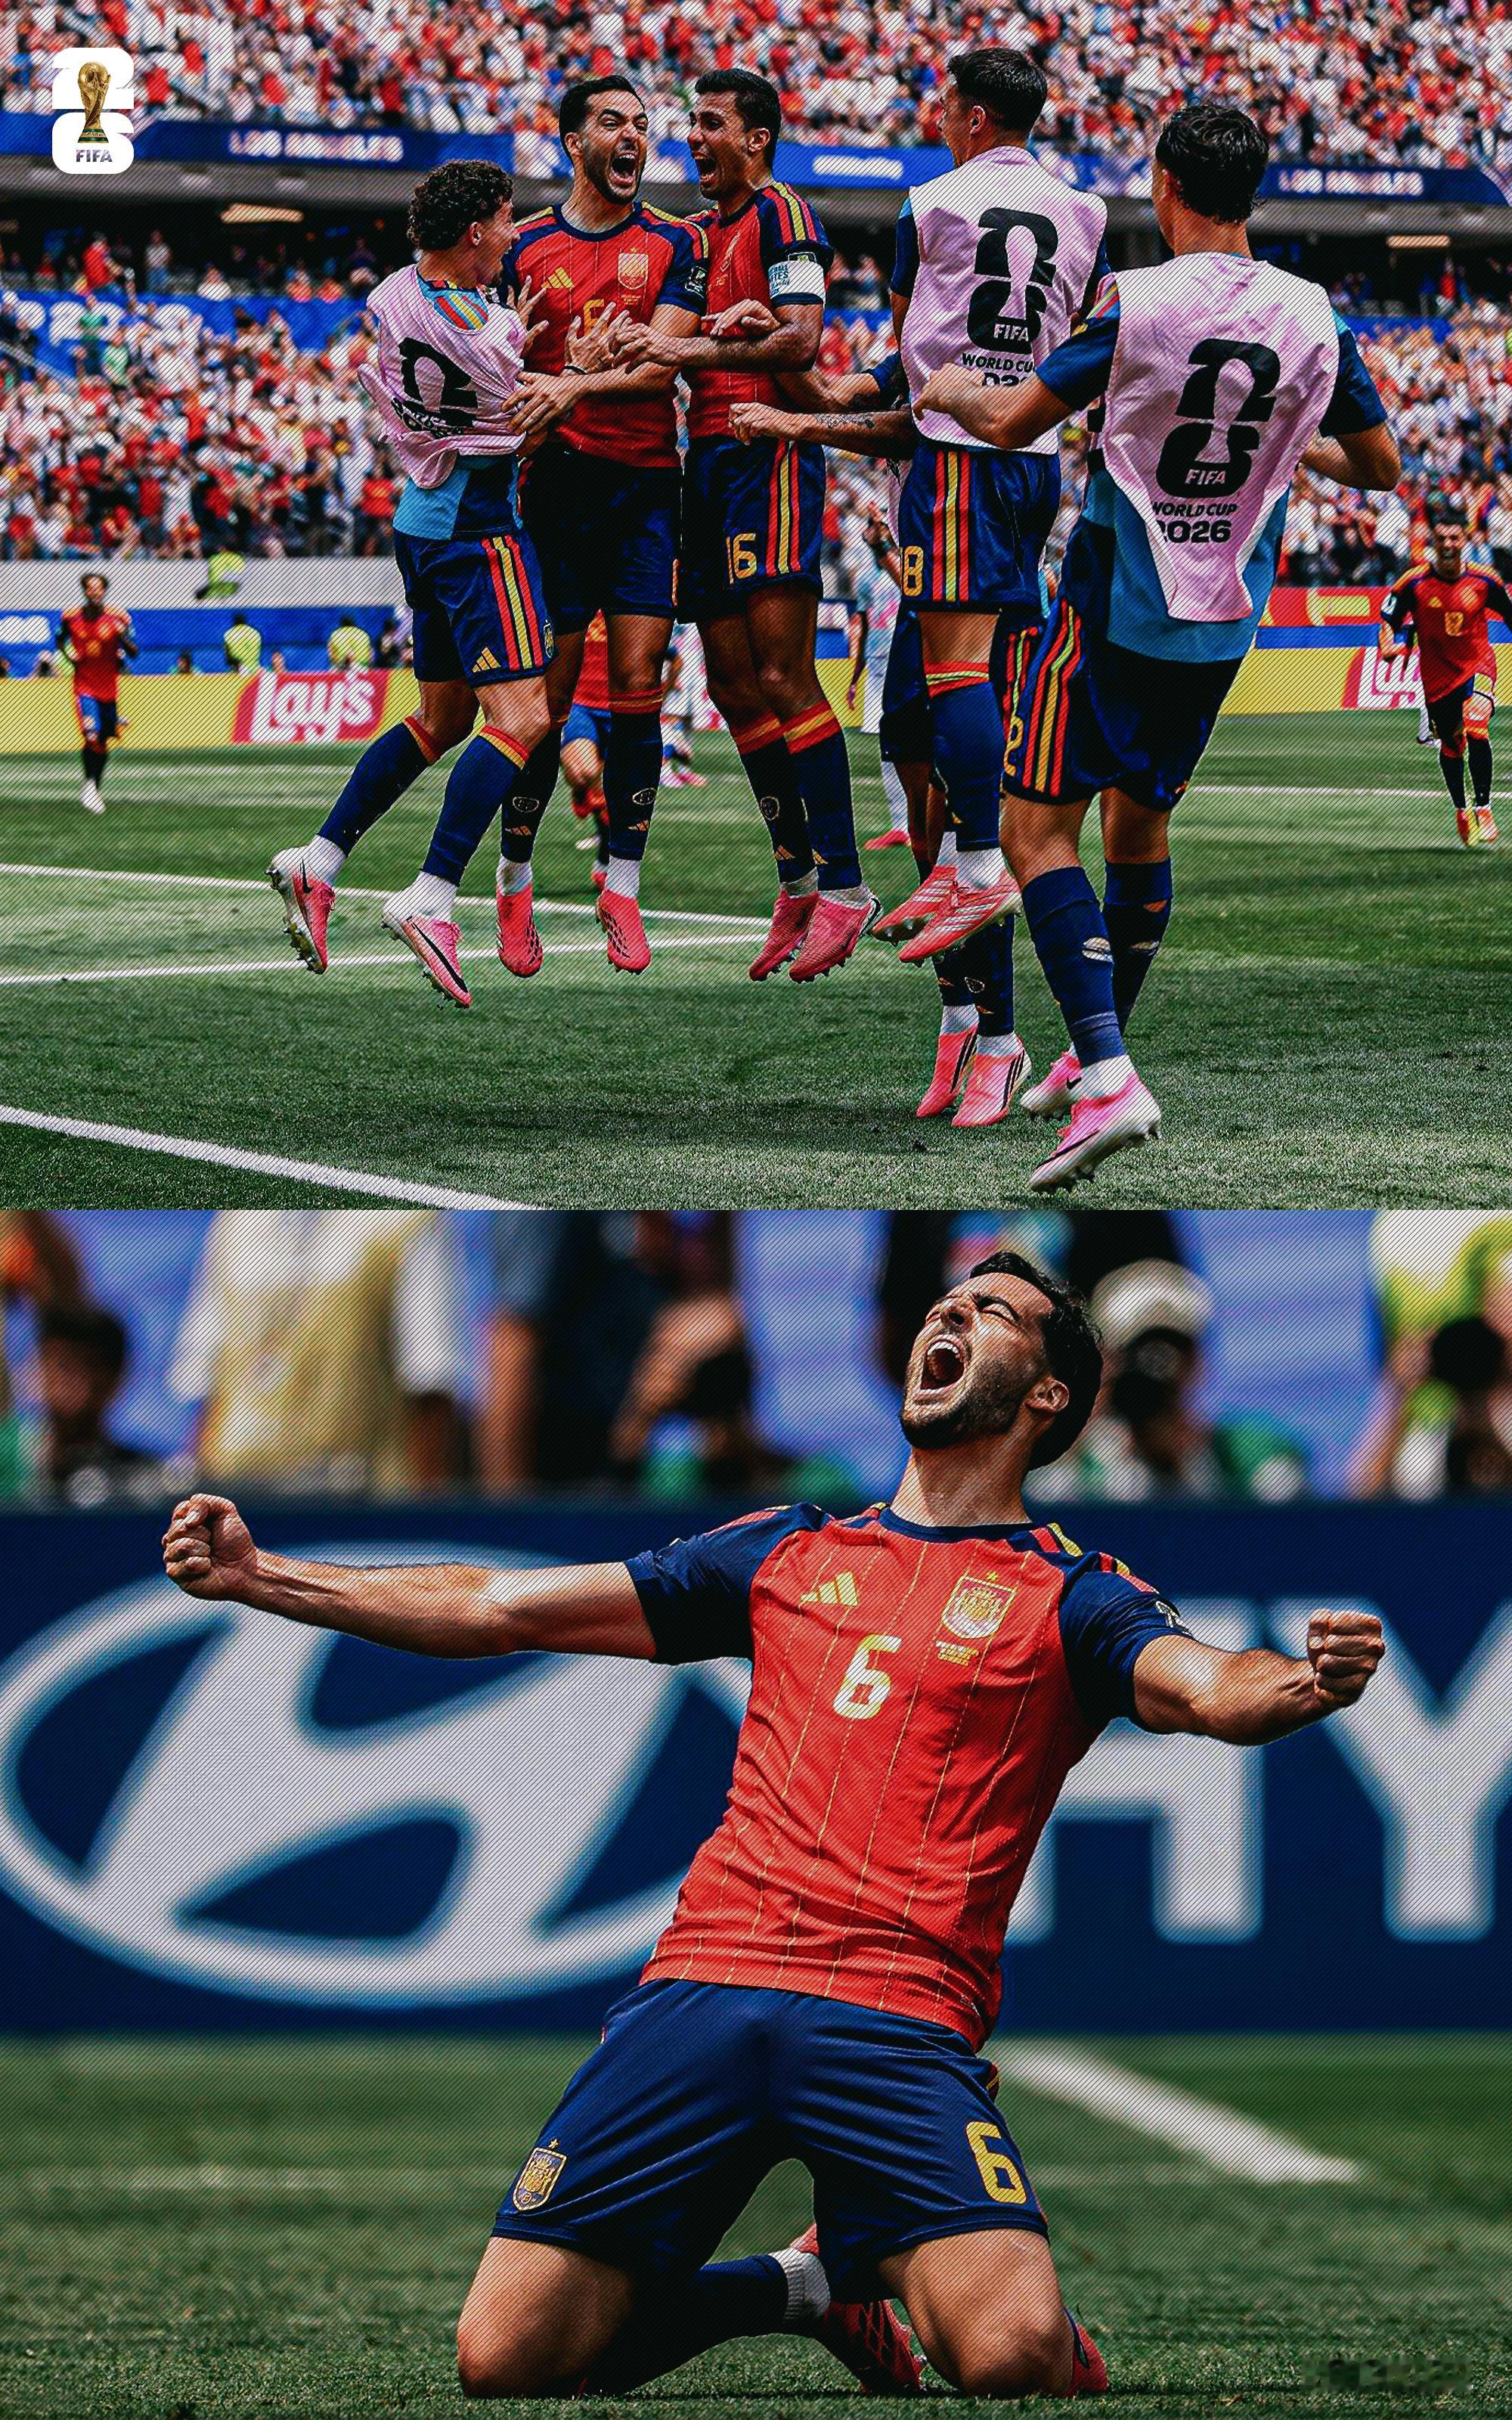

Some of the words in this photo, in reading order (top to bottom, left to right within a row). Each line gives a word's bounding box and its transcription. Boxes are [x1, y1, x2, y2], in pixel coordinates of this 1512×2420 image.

[993, 323, 1029, 342] FIFA
[962, 352, 1014, 371] WORLD
[1016, 361, 1035, 374] CU
[1185, 468, 1226, 486] FIFA
[1151, 501, 1206, 517] WORLD
[1207, 503, 1238, 517] CUP
[249, 670, 375, 743] Lay's
[833, 1634, 903, 1720] 6
[966, 2121, 1027, 2204] 6
